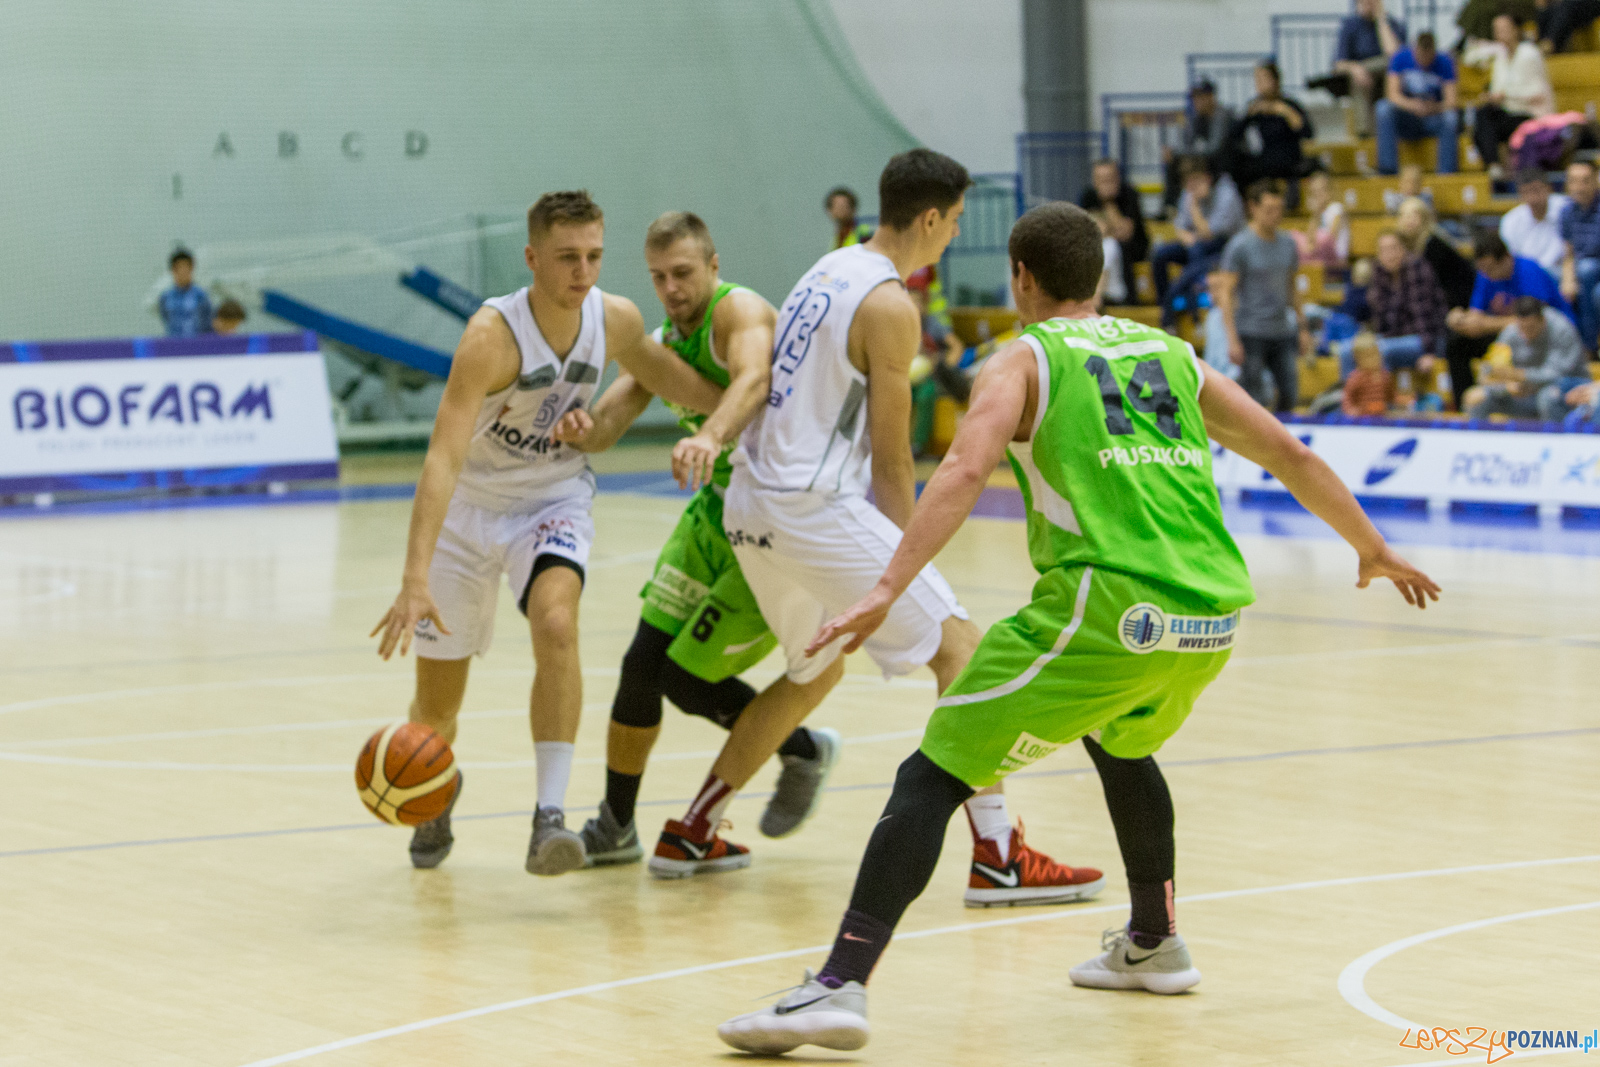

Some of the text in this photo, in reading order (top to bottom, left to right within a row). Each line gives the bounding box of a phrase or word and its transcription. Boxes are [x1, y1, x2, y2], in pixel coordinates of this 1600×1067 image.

[213, 131, 429, 158] A B C D
[12, 380, 273, 430] BIOFARM
[1084, 355, 1182, 439] 14
[692, 605, 721, 642] 6
